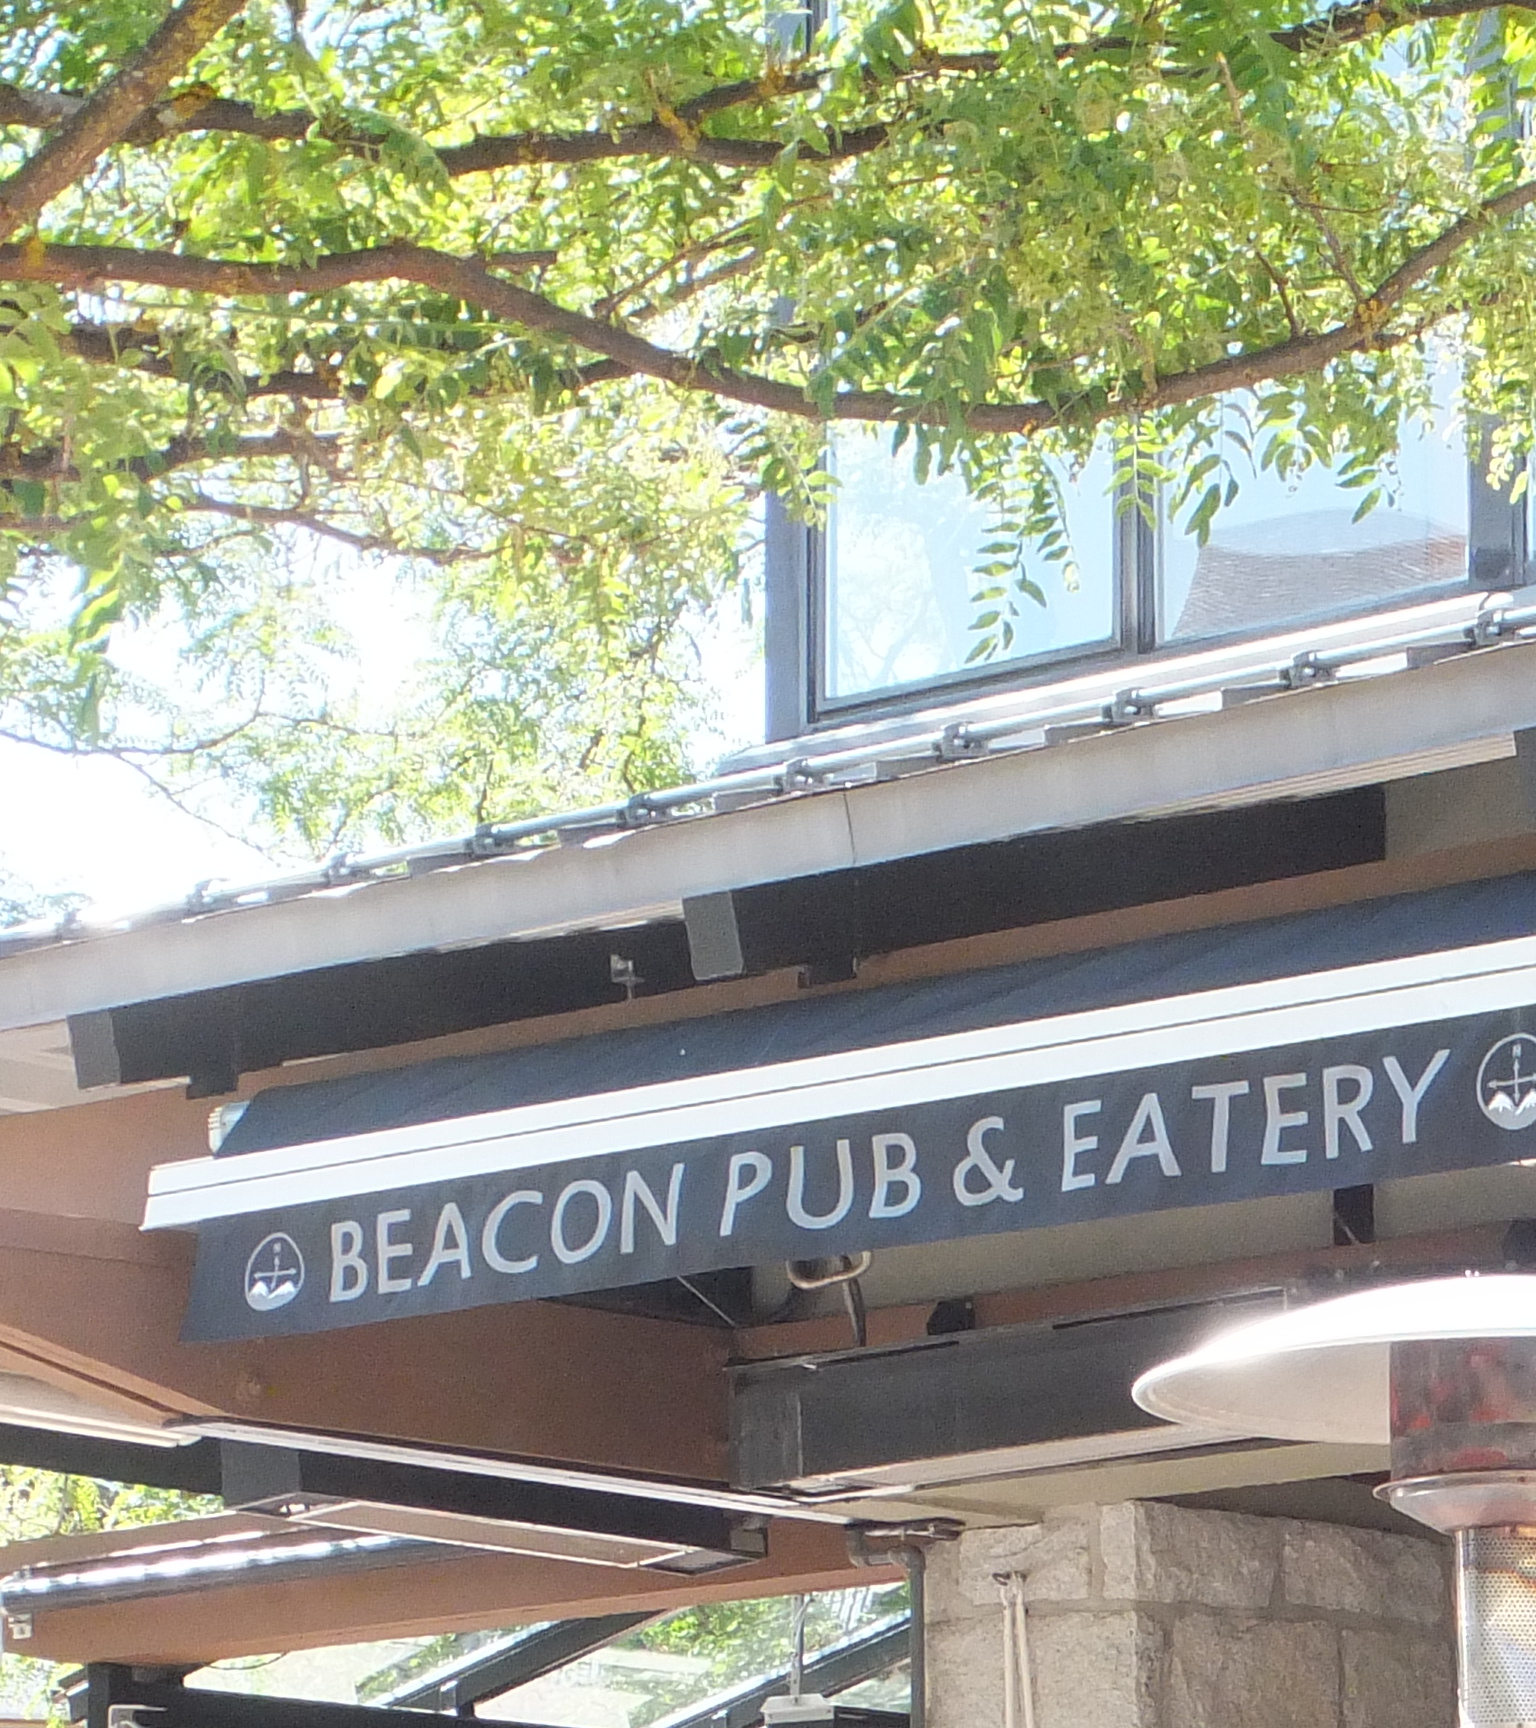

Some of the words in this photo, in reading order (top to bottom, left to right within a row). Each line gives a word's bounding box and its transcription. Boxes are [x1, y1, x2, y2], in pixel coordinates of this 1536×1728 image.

[328, 1161, 686, 1304] BEACON
[718, 1131, 922, 1239] PUB
[951, 1114, 1025, 1207] &
[1059, 1047, 1452, 1194] EATERY
